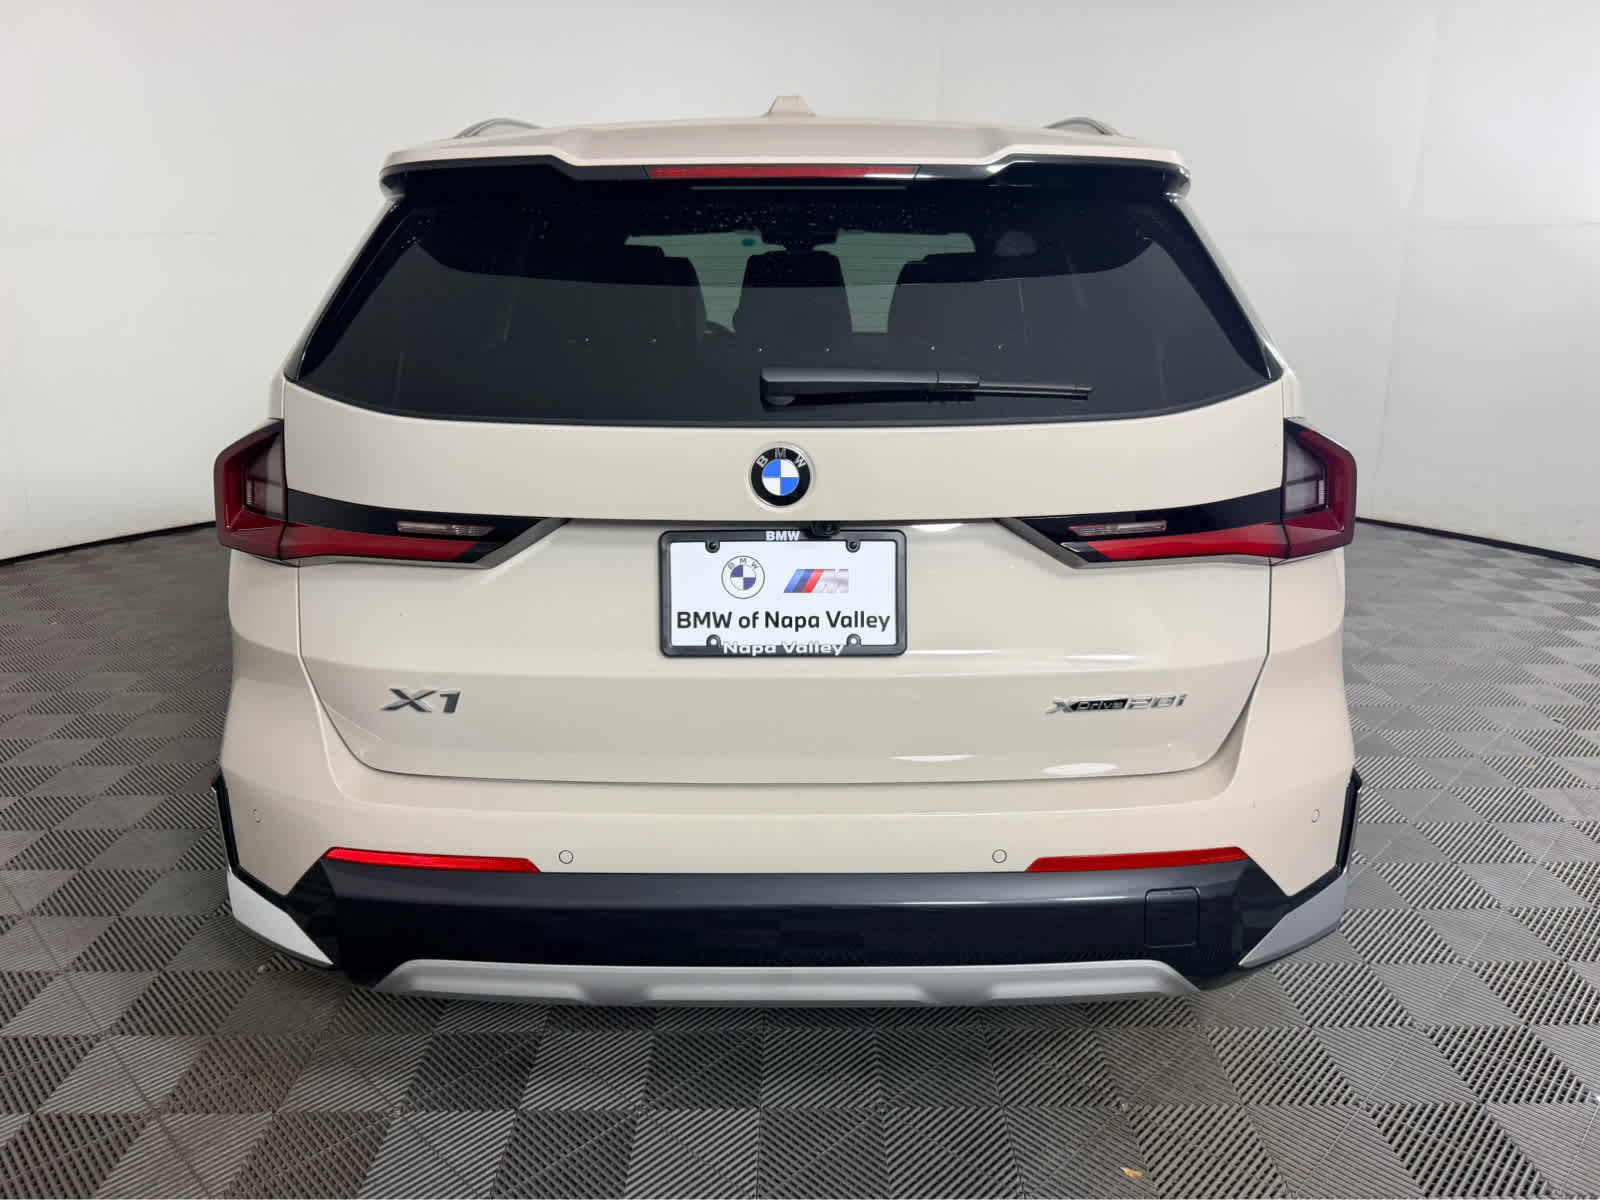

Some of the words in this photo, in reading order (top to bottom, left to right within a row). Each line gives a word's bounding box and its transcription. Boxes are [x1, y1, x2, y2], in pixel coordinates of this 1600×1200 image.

[755, 447, 807, 468] BMW
[765, 530, 801, 541] BMW
[727, 557, 759, 570] BMW
[676, 611, 732, 629] BMW
[738, 611, 760, 629] of
[764, 611, 820, 632] Napa
[825, 610, 891, 632] Valley
[722, 641, 777, 656] Napa
[780, 641, 845, 656] Valley
[379, 687, 463, 714] X1
